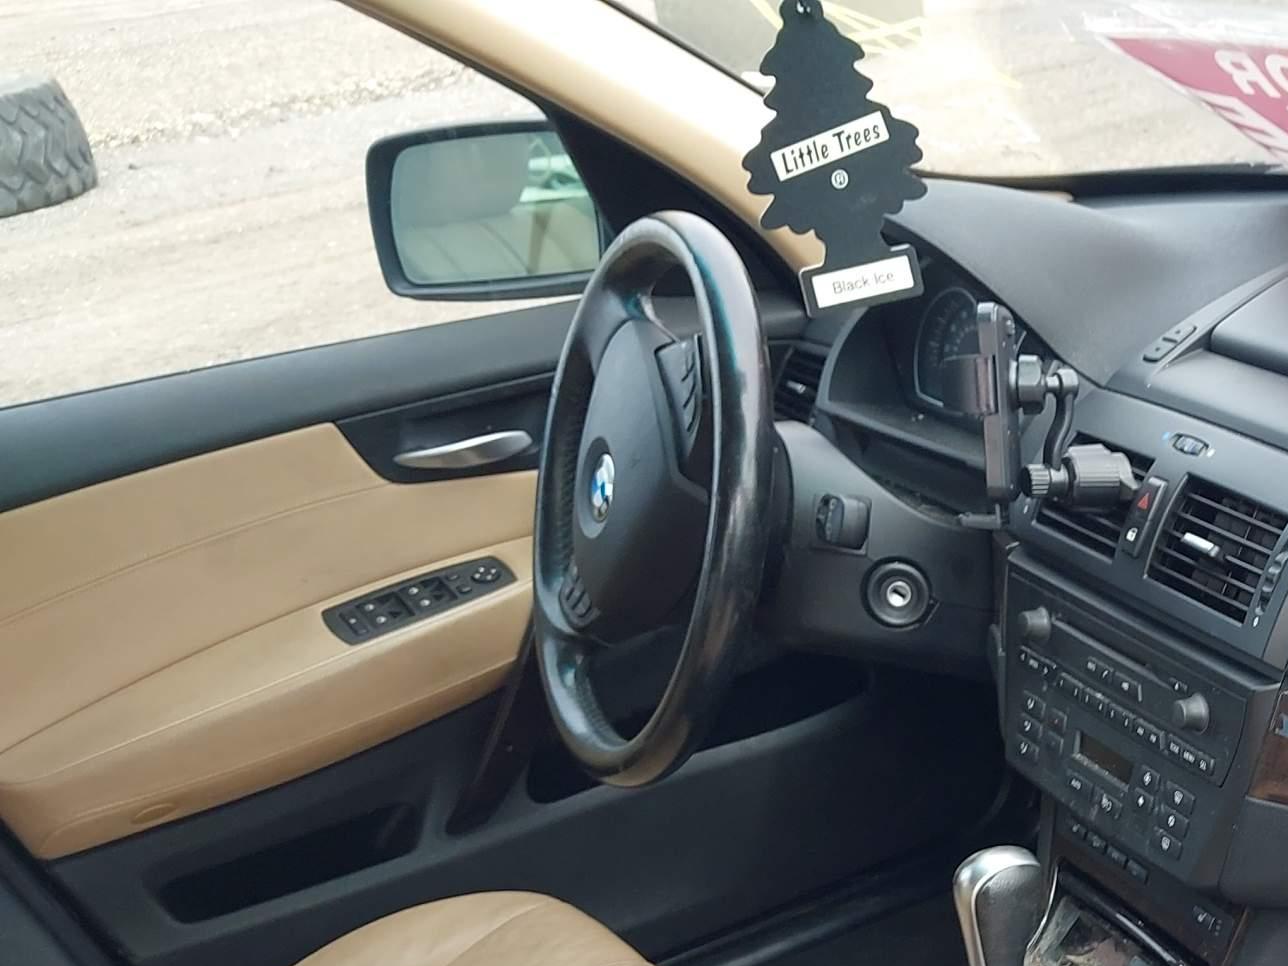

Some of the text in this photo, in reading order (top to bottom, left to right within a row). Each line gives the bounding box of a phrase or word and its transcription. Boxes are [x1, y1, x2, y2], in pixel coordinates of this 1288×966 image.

[781, 124, 880, 174] Little Trees
[832, 271, 895, 295] Black Ice
